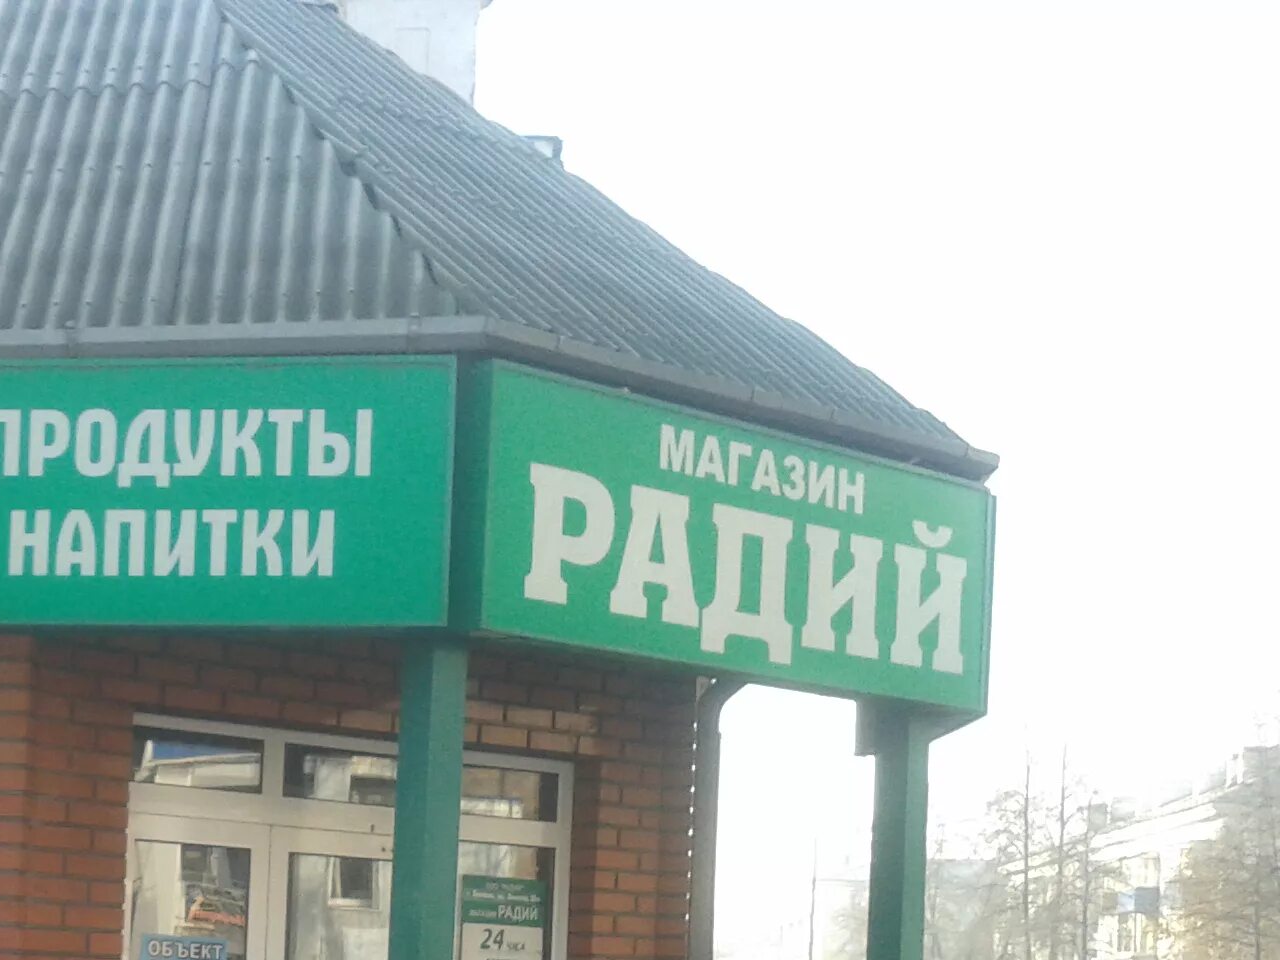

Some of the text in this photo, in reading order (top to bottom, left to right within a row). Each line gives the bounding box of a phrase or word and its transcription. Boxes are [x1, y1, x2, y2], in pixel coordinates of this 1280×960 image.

[659, 423, 866, 515] МАГАЗИН
[7, 509, 336, 577] НАПИТКИ
[524, 462, 968, 675] РАДИЙ
[497, 904, 538, 922] РАДИЙ
[148, 940, 223, 960] ОБЪЕКТ
[480, 928, 505, 951] 24
